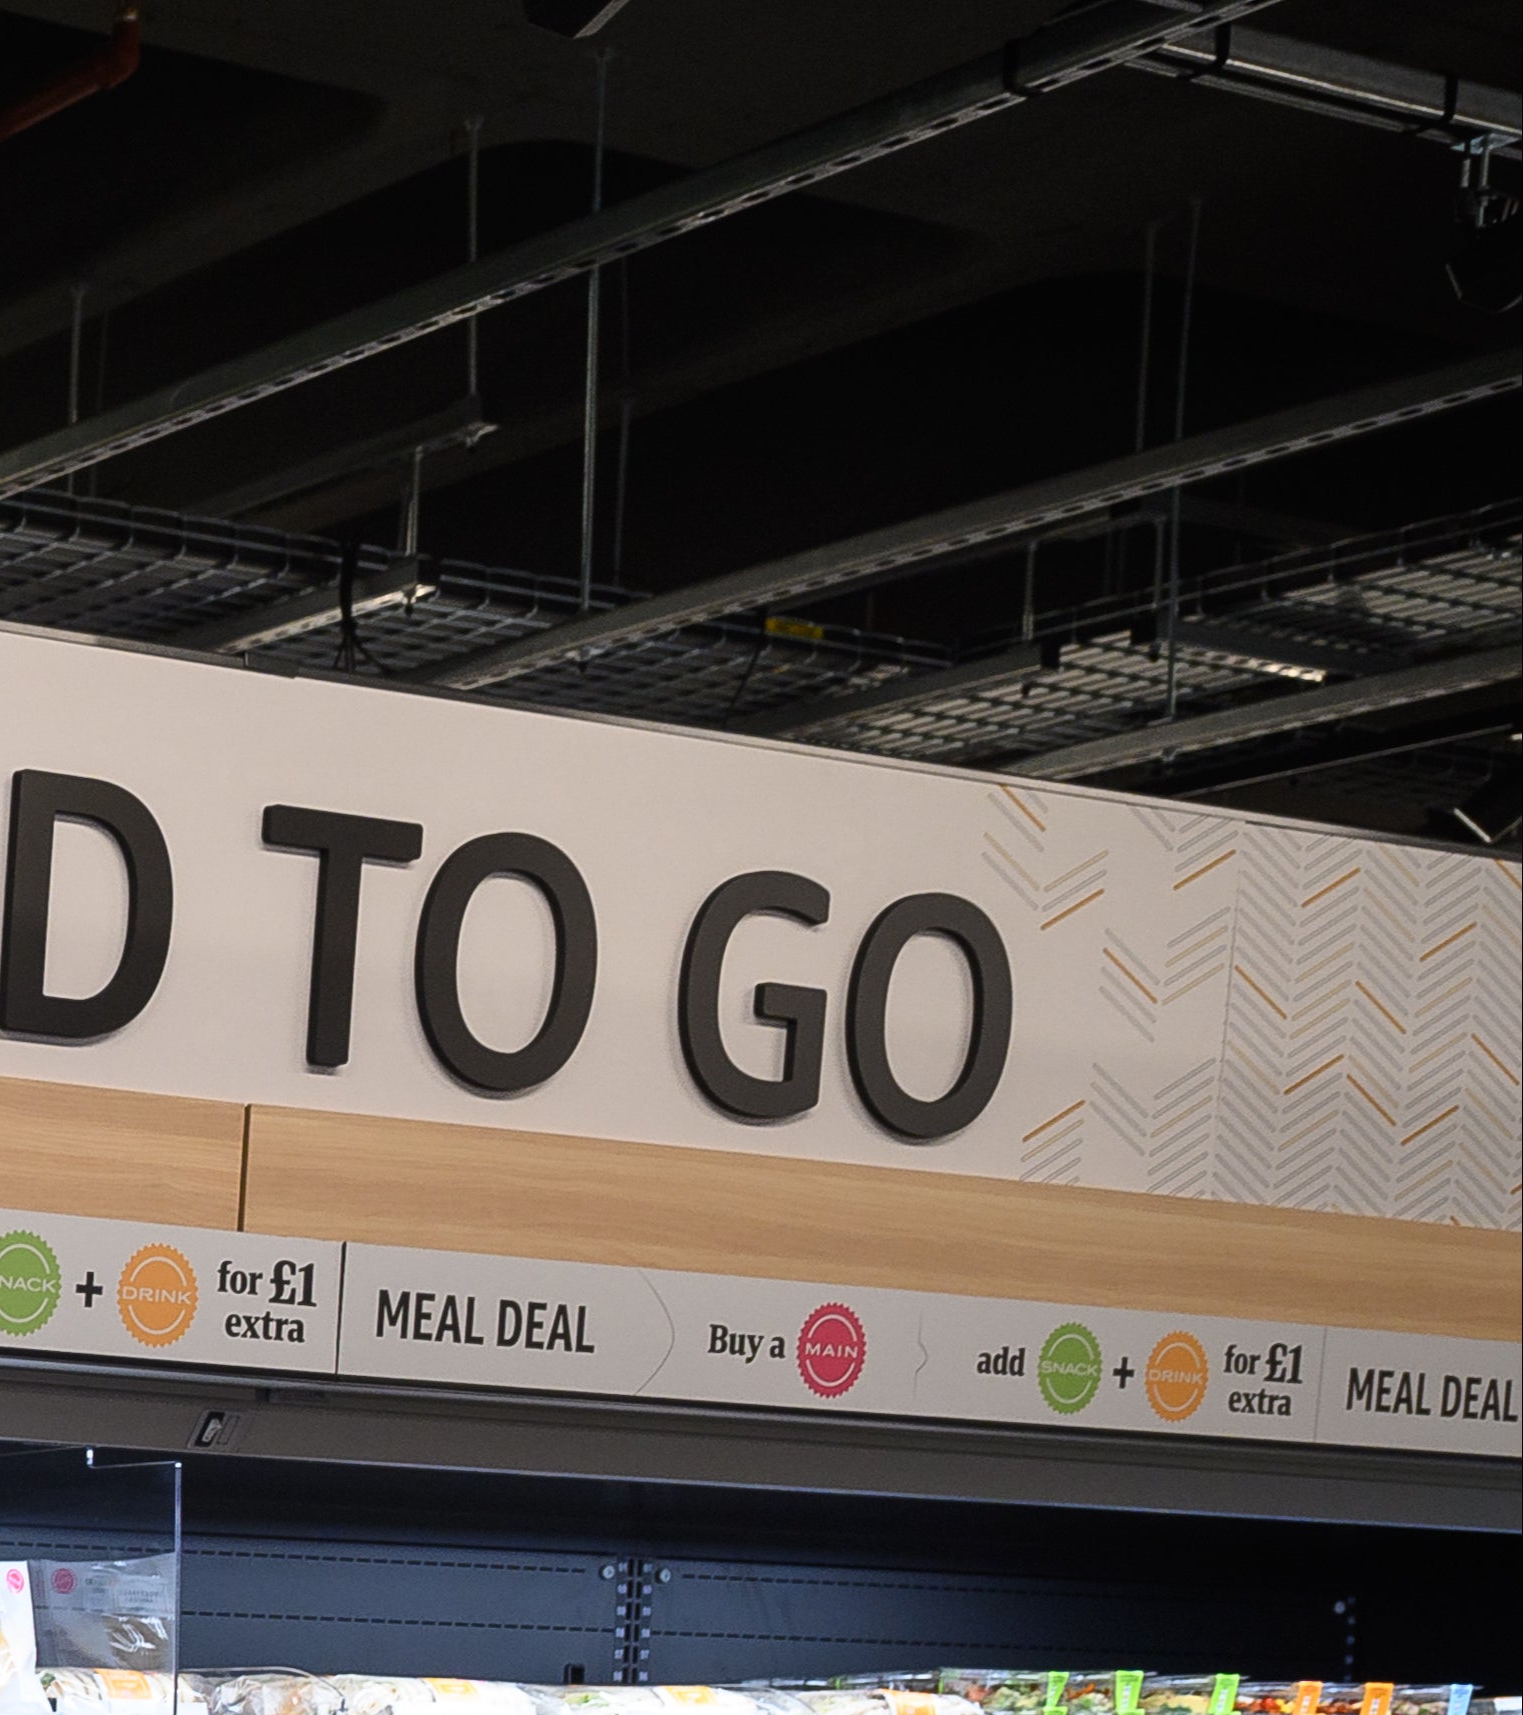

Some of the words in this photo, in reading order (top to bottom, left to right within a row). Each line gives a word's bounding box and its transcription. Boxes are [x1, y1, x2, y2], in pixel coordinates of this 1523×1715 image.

[262, 803, 599, 1098] TO
[677, 868, 1016, 1144] GO
[122, 1284, 192, 1305] DRINK
[217, 1260, 264, 1297] for
[269, 1261, 317, 1308] £1
[224, 1309, 306, 1344] extra
[375, 1288, 485, 1345] MEAL
[495, 1298, 596, 1354] DEAL
[707, 1323, 763, 1364] Buy
[769, 1332, 786, 1359] a
[804, 1342, 859, 1358] MAIN
[976, 1345, 1026, 1377] add
[1040, 1360, 1099, 1378] SNACK
[1148, 1368, 1204, 1384] DRINK
[1223, 1343, 1261, 1375] for
[1264, 1342, 1303, 1385] £1
[1227, 1387, 1292, 1417] extra
[1346, 1366, 1431, 1416] MEAL
[1439, 1374, 1519, 1423] DEAL
